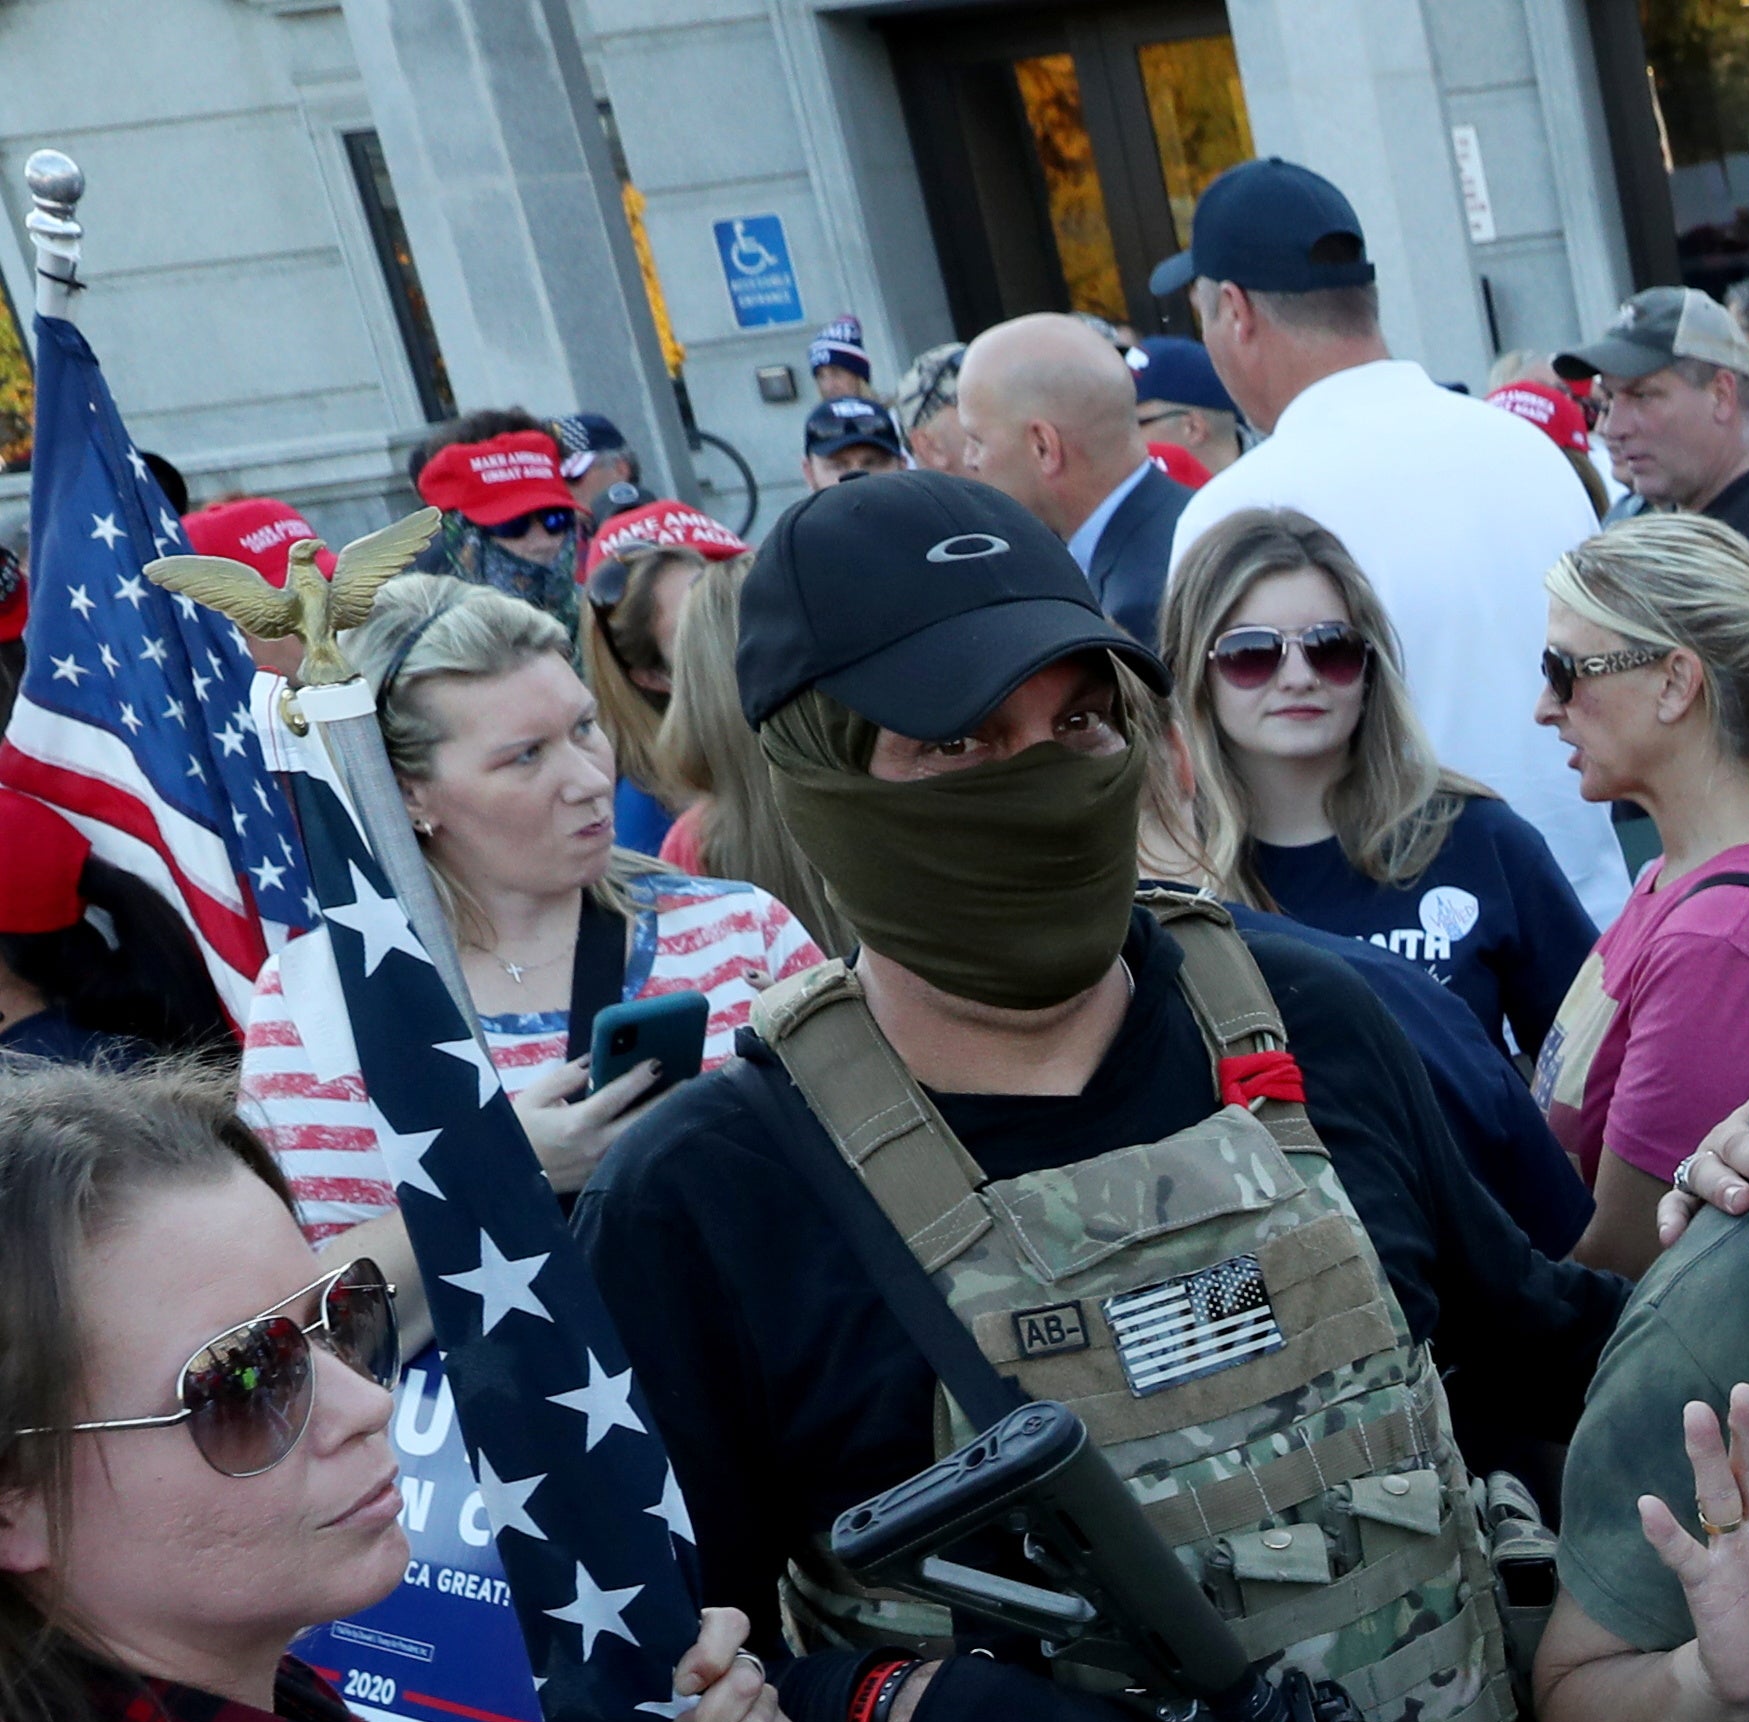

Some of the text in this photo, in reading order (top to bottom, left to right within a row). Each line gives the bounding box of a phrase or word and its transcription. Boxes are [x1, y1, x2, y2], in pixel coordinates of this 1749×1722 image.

[1026, 1314, 1080, 1349] AB-
[436, 1567, 511, 1607] GREAT!
[343, 1669, 397, 1705] 2020
